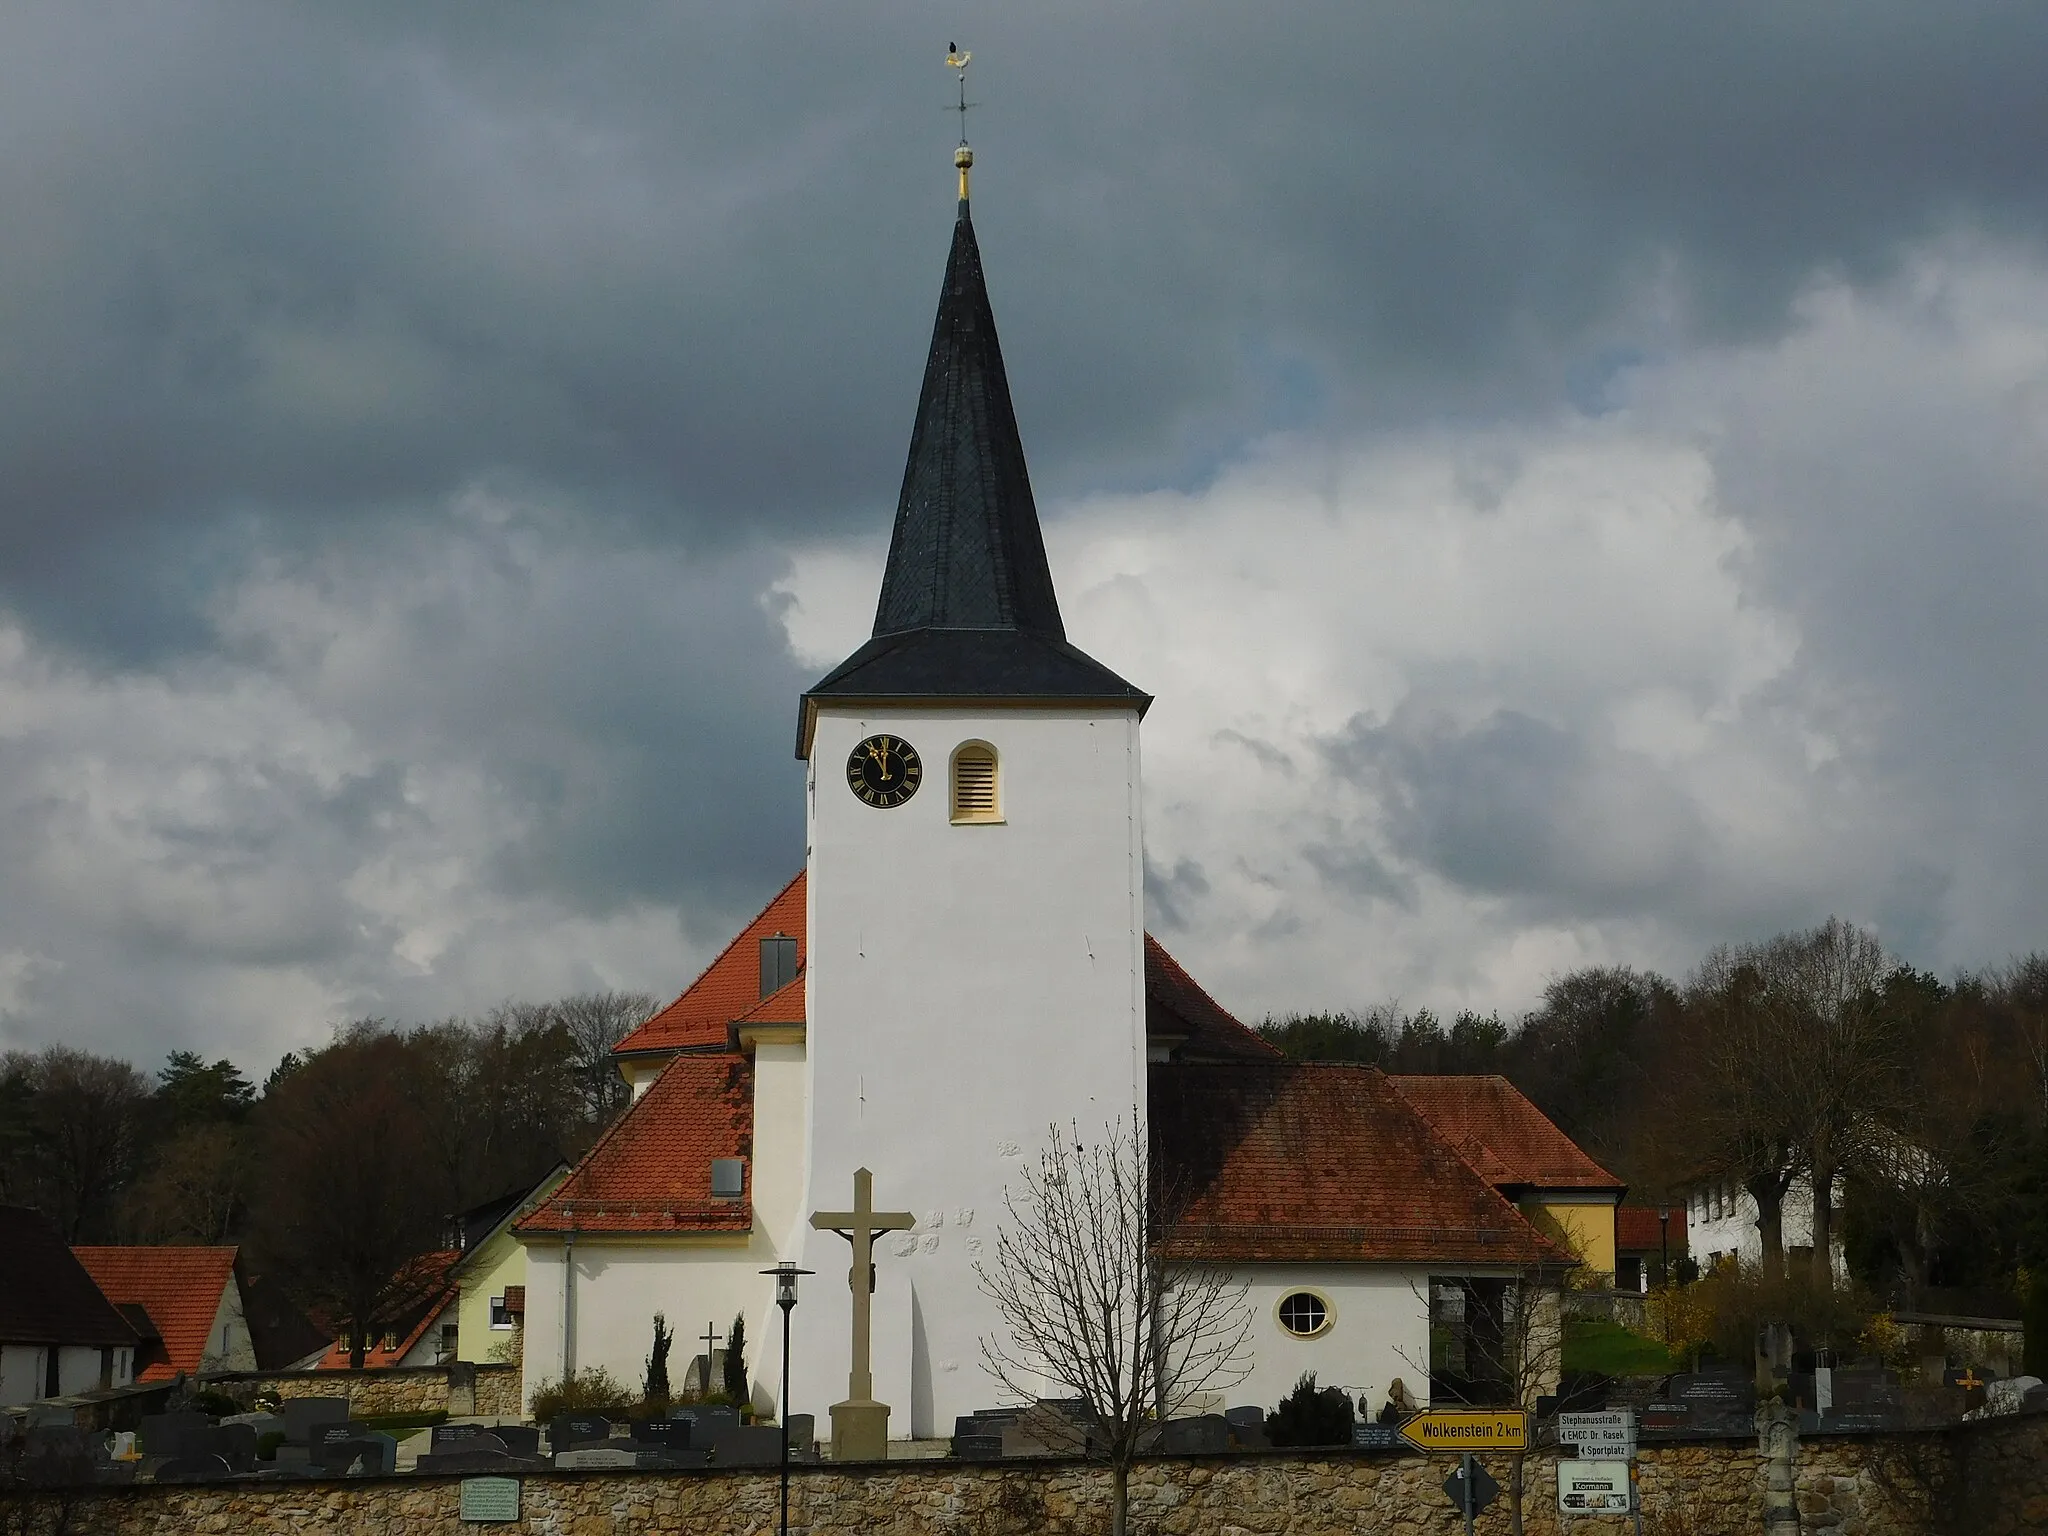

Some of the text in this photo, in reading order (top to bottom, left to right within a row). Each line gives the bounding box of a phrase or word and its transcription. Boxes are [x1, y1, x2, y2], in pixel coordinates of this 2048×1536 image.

[1562, 1415, 1621, 1426] Stephanusstraße
[1422, 1422, 1520, 1437] Wolkenstein 2 km
[1568, 1430, 1624, 1440] EMCC Dr. Rasek
[1588, 1446, 1624, 1456] Sportplatz
